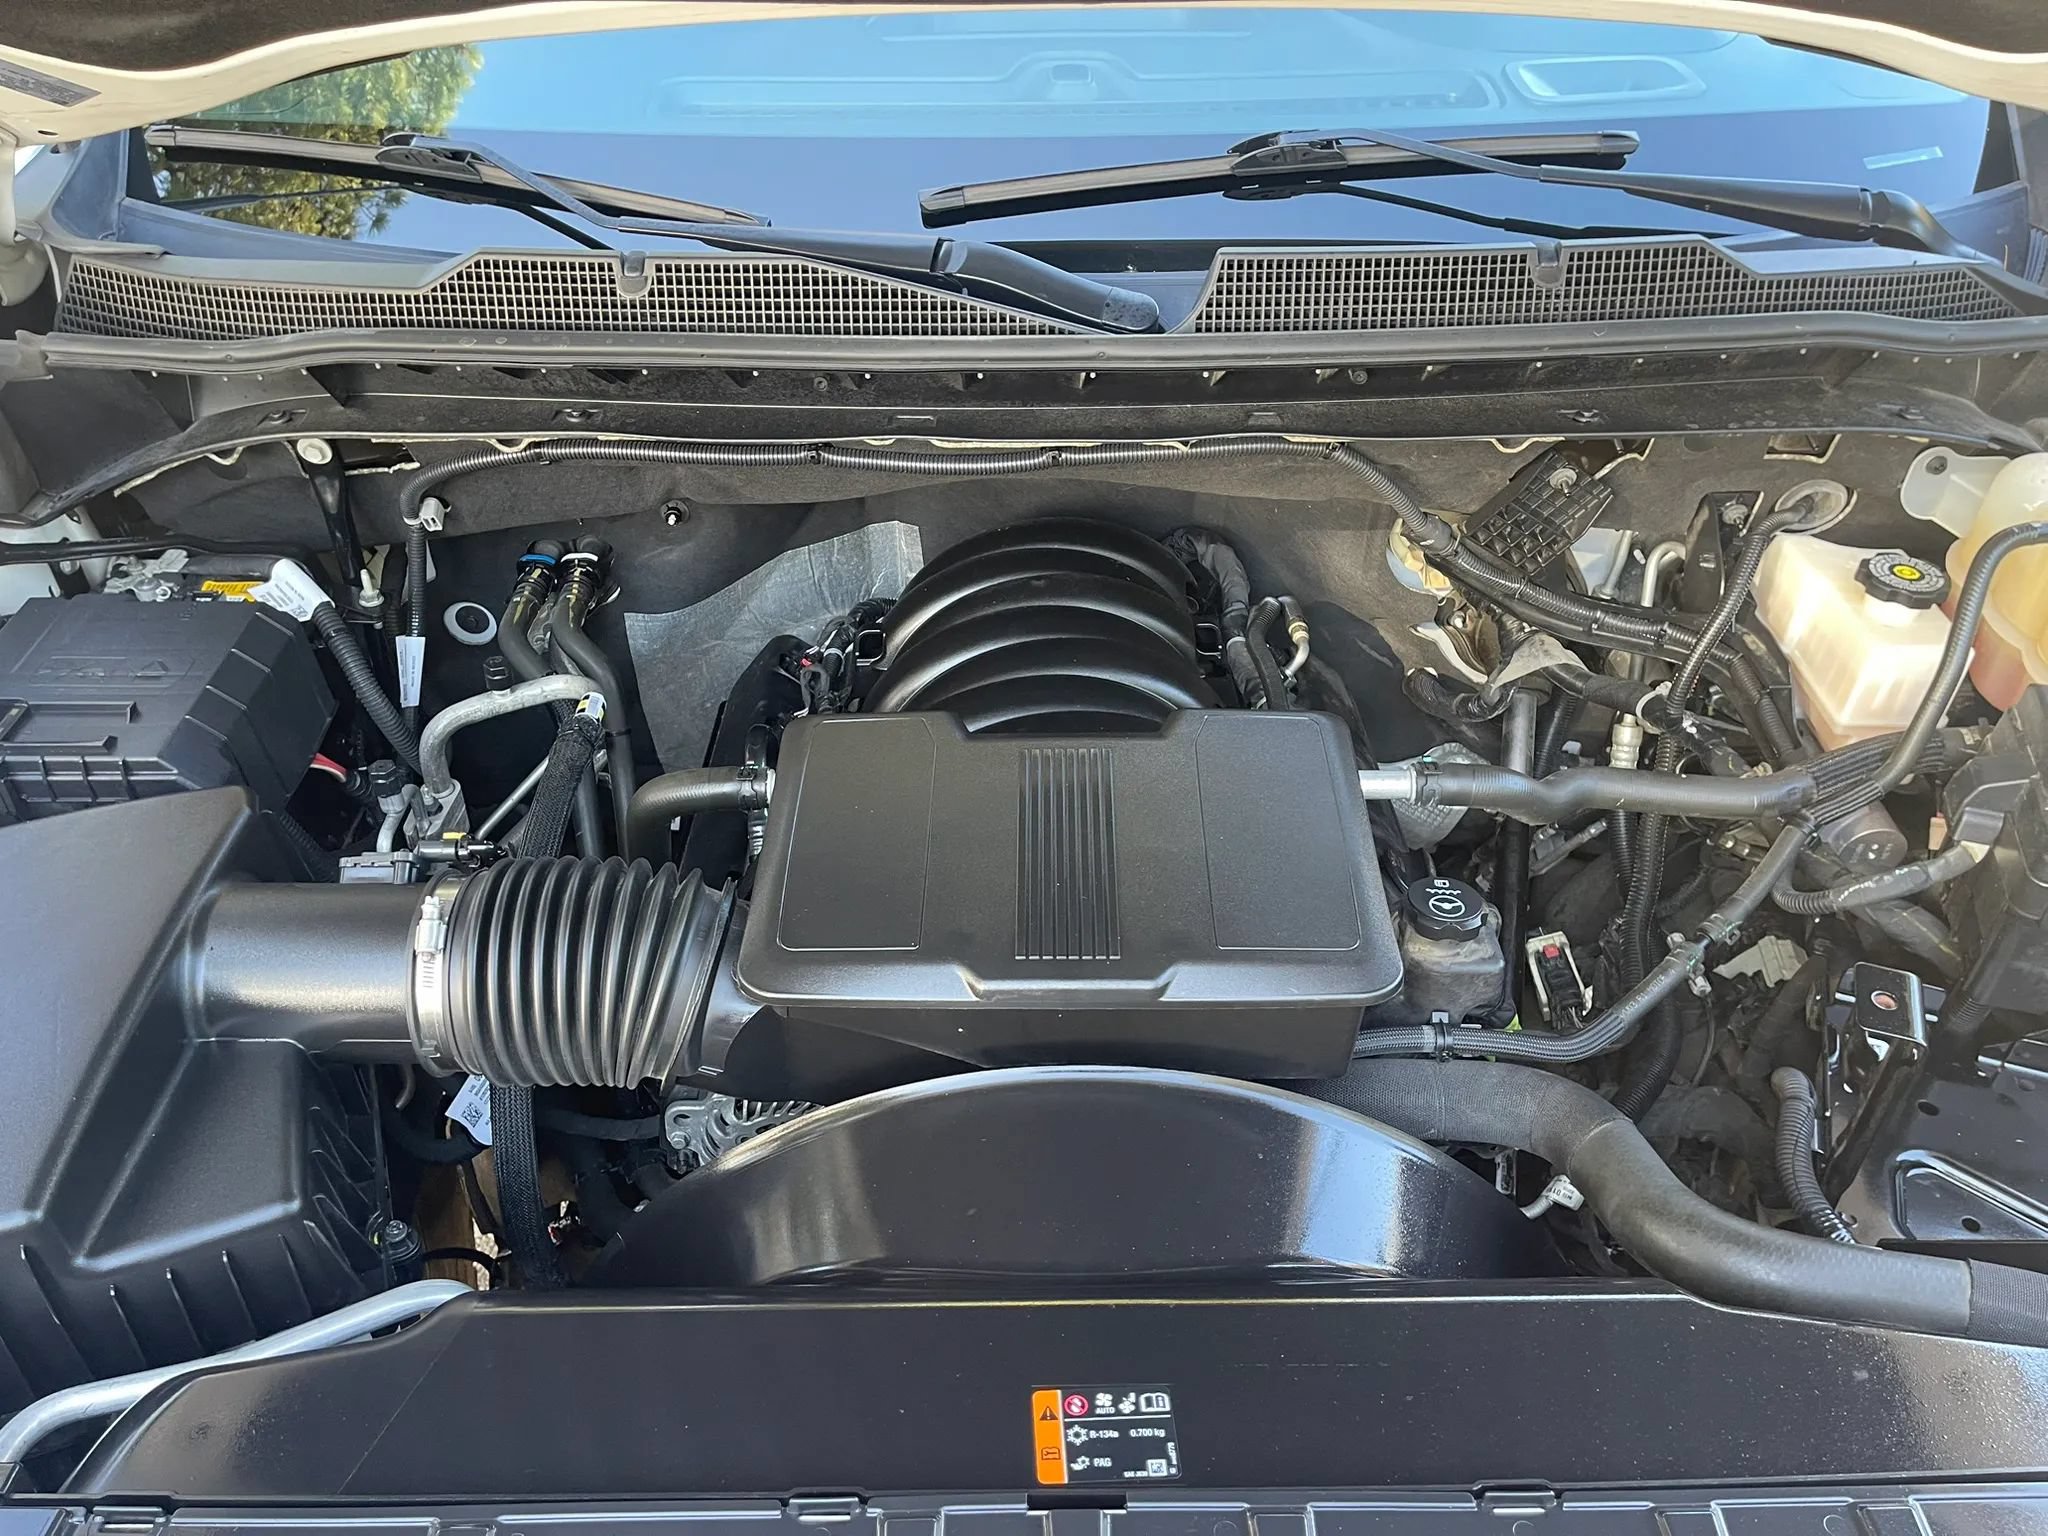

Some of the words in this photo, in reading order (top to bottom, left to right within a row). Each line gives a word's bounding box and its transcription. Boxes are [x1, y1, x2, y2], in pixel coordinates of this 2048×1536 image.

[1089, 1430, 1119, 1438] R-134a
[1130, 1429, 1153, 1437] 0.700
[1154, 1428, 1166, 1438] kg
[1093, 1457, 1112, 1467] PAG
